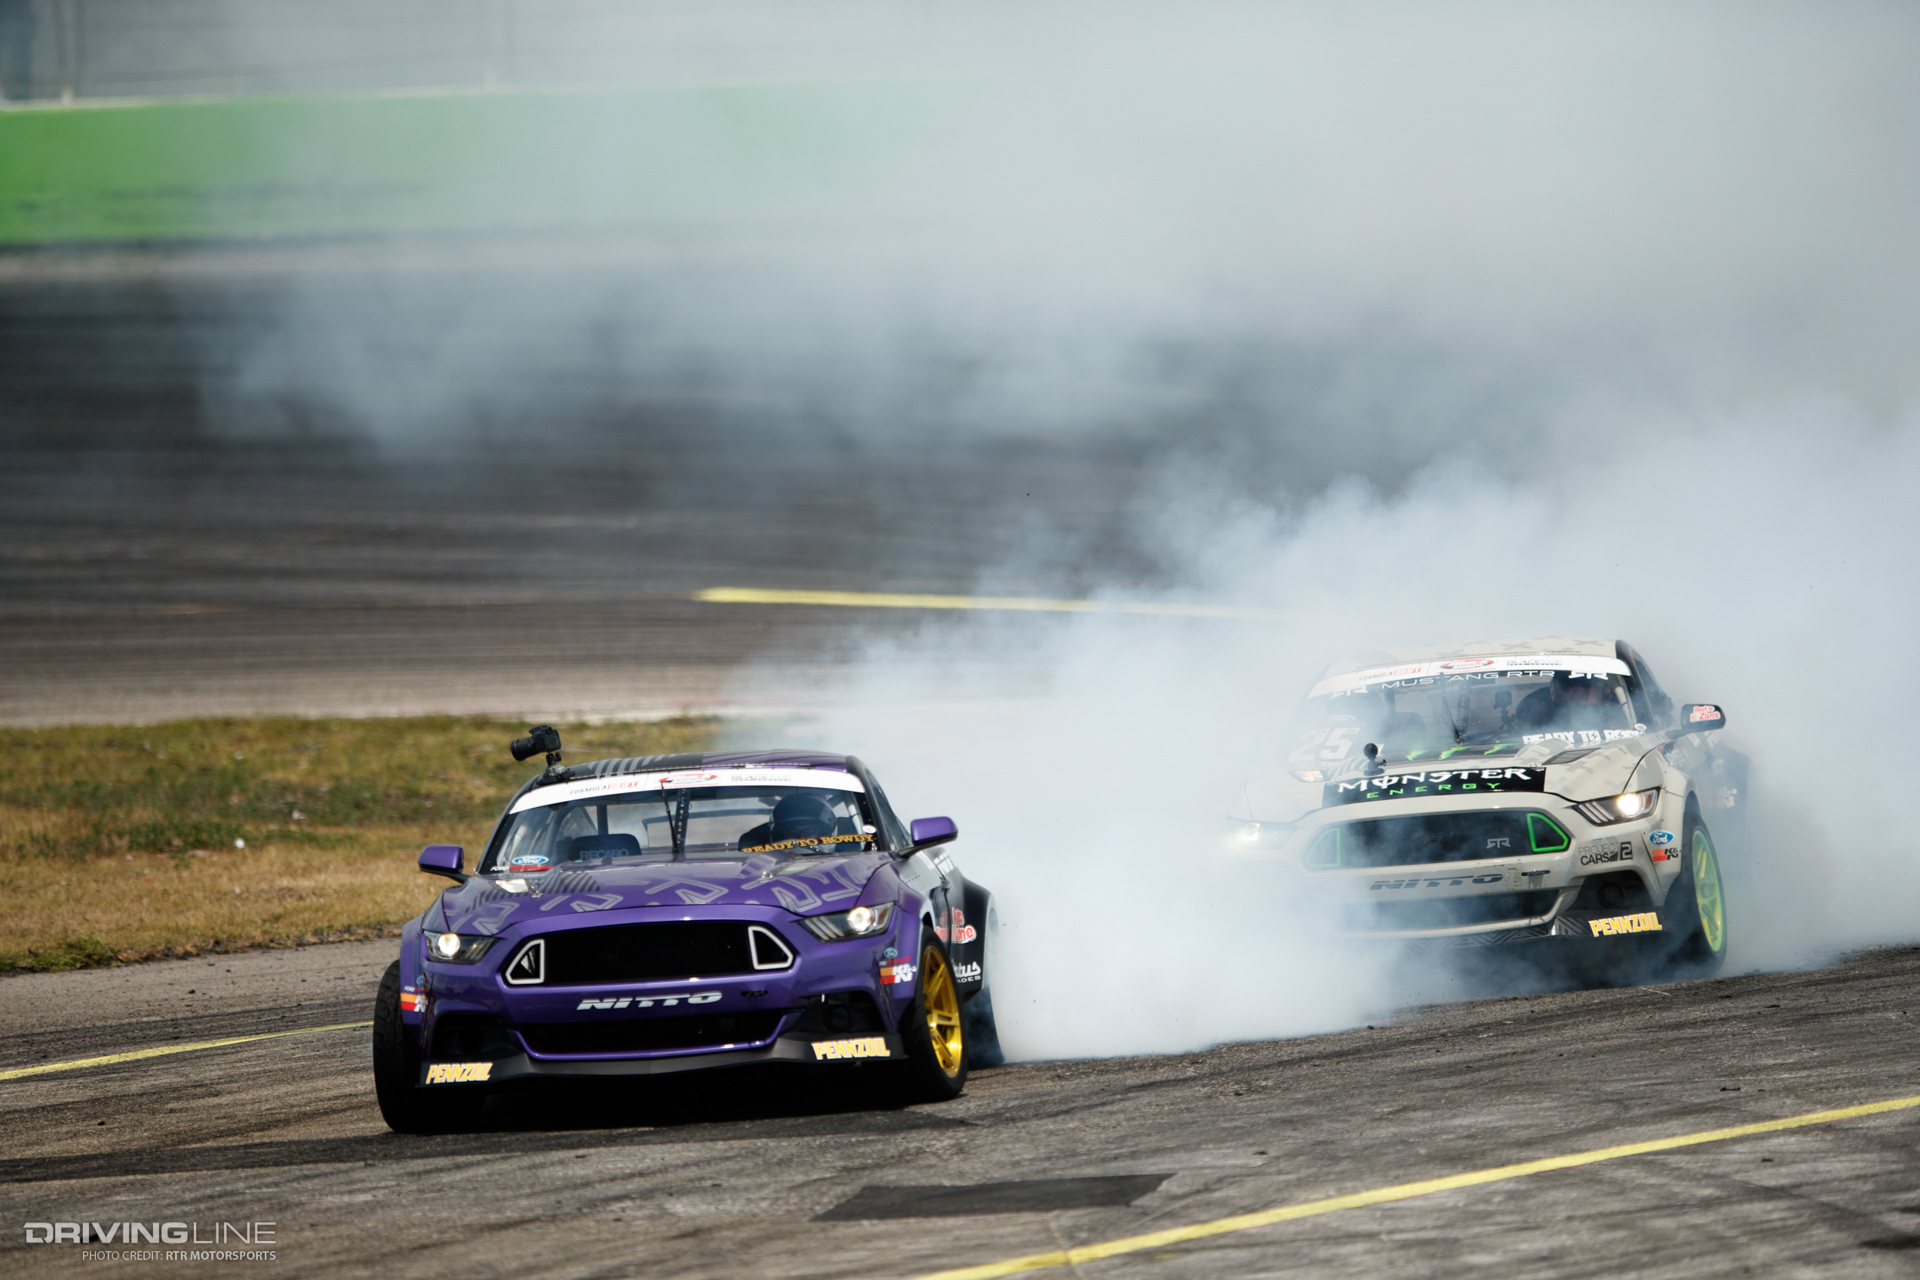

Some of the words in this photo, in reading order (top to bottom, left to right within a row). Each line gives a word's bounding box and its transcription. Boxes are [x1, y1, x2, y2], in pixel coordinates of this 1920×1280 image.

[1359, 671, 1393, 681] FORMULA
[1381, 671, 1499, 690] MUSTANG
[1507, 670, 1556, 678] RTR
[1699, 711, 1720, 720] Zone
[1287, 727, 1361, 762] 25
[1337, 767, 1532, 794] MONSTER
[1366, 782, 1501, 799] ENERGY
[741, 841, 794, 853] READY
[795, 838, 819, 848] TO
[820, 833, 874, 845] ROWDY
[1651, 831, 1671, 845] Ford
[580, 848, 630, 861] RECARO
[1578, 842, 1620, 856] PROJECT
[1621, 842, 1632, 860] 2
[1580, 852, 1611, 866] CARS
[1369, 873, 1504, 891] NITTO
[1588, 912, 1663, 938] PENNZOIL
[892, 963, 917, 984] K&N
[576, 991, 723, 1011] NITTO
[811, 1036, 891, 1061] PENNZOIL
[425, 1062, 494, 1085] PENNZOIL
